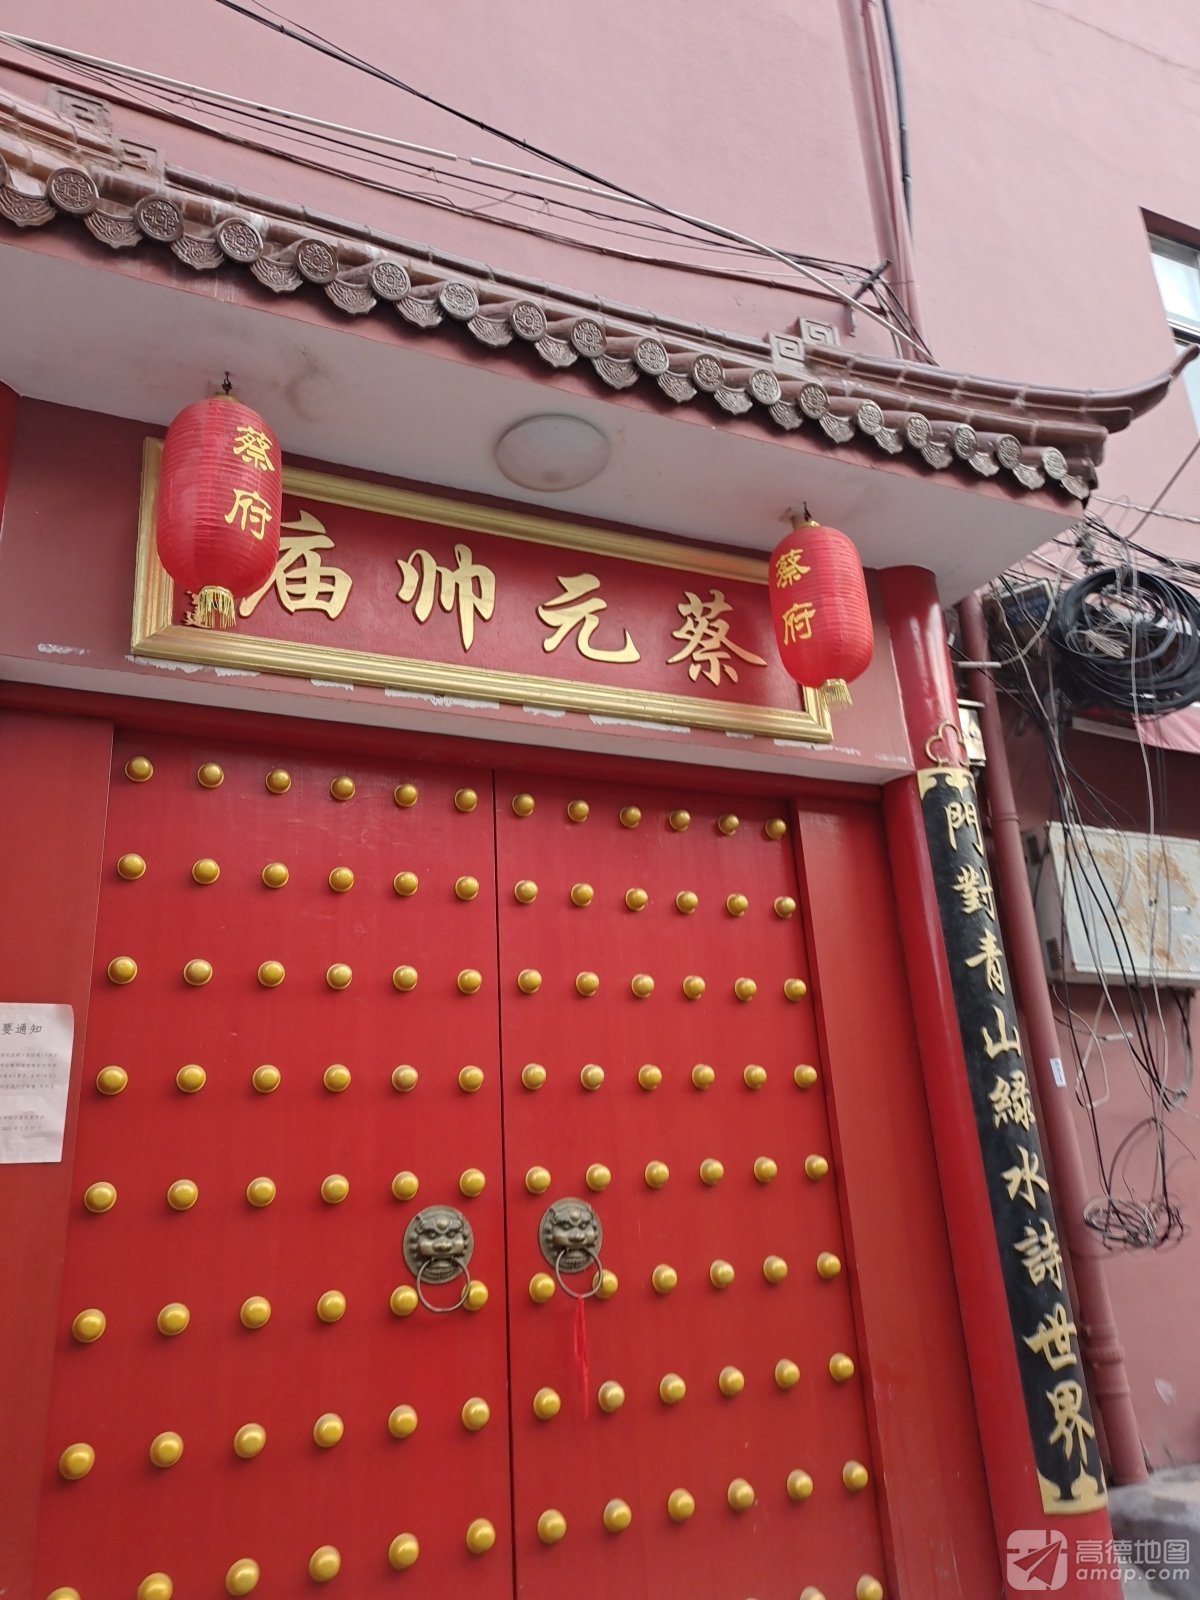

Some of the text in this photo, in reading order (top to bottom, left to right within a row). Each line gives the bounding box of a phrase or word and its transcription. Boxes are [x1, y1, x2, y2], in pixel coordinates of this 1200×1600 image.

[225, 424, 276, 541] 蔡府
[774, 547, 816, 648] 蔡府
[0, 1022, 43, 1036] 要通知
